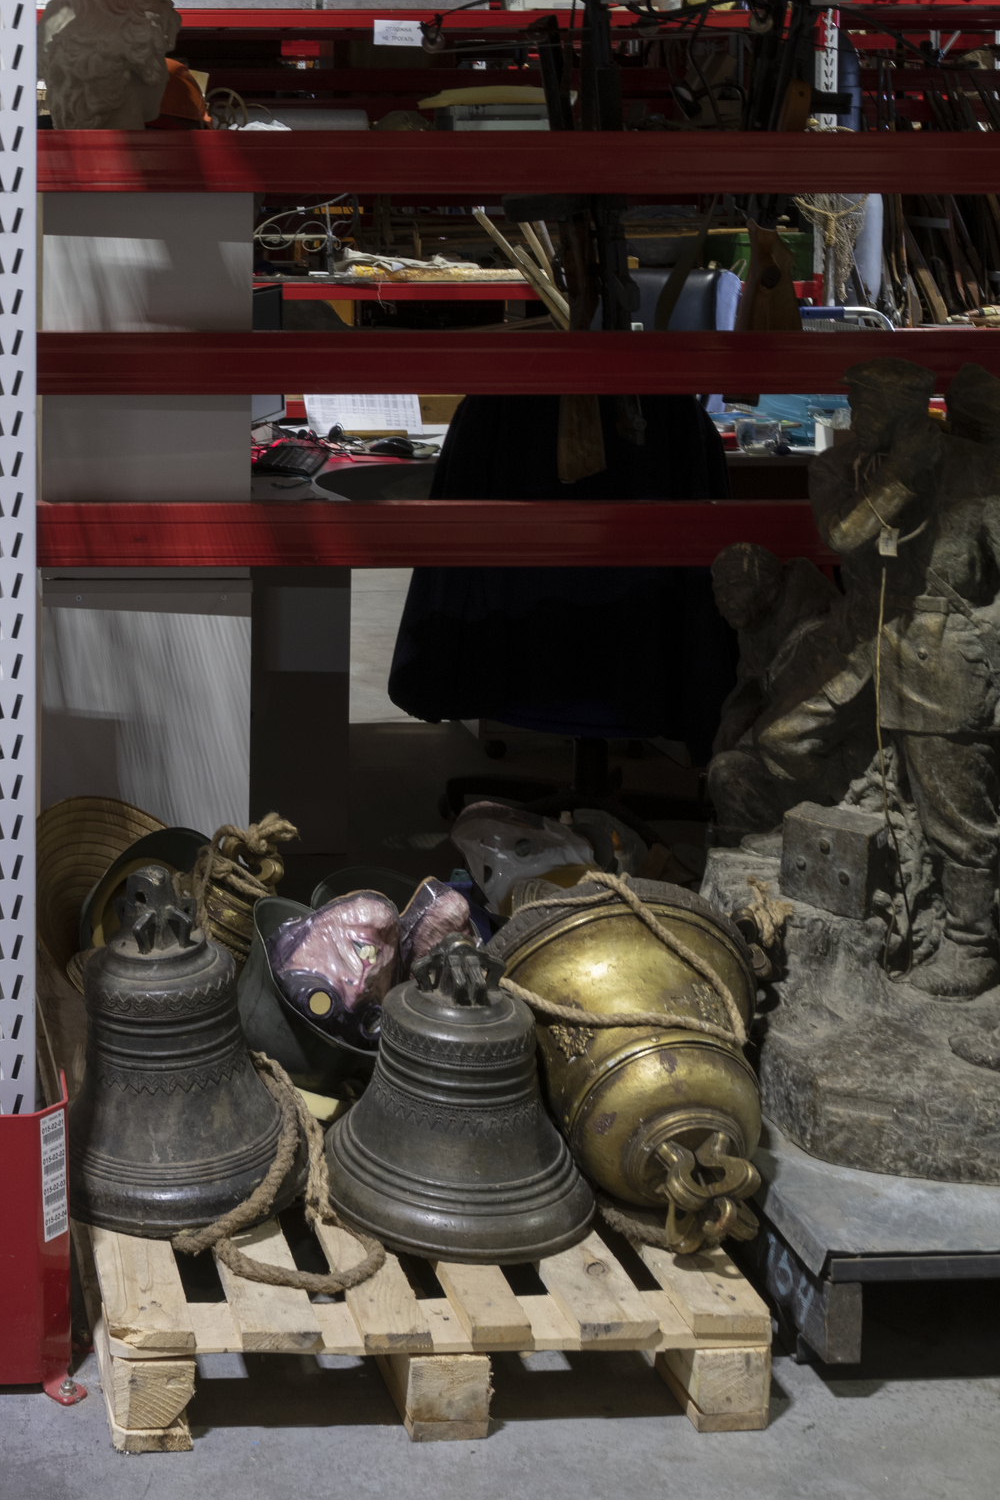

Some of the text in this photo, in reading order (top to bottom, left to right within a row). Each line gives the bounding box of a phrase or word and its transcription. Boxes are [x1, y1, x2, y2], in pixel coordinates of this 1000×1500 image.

[41, 1119, 64, 1135] 015-02-01
[42, 1149, 65, 1166] 015-02-02
[43, 1179, 66, 1196] 015-02-03
[45, 1209, 67, 1226] 015-02-04
